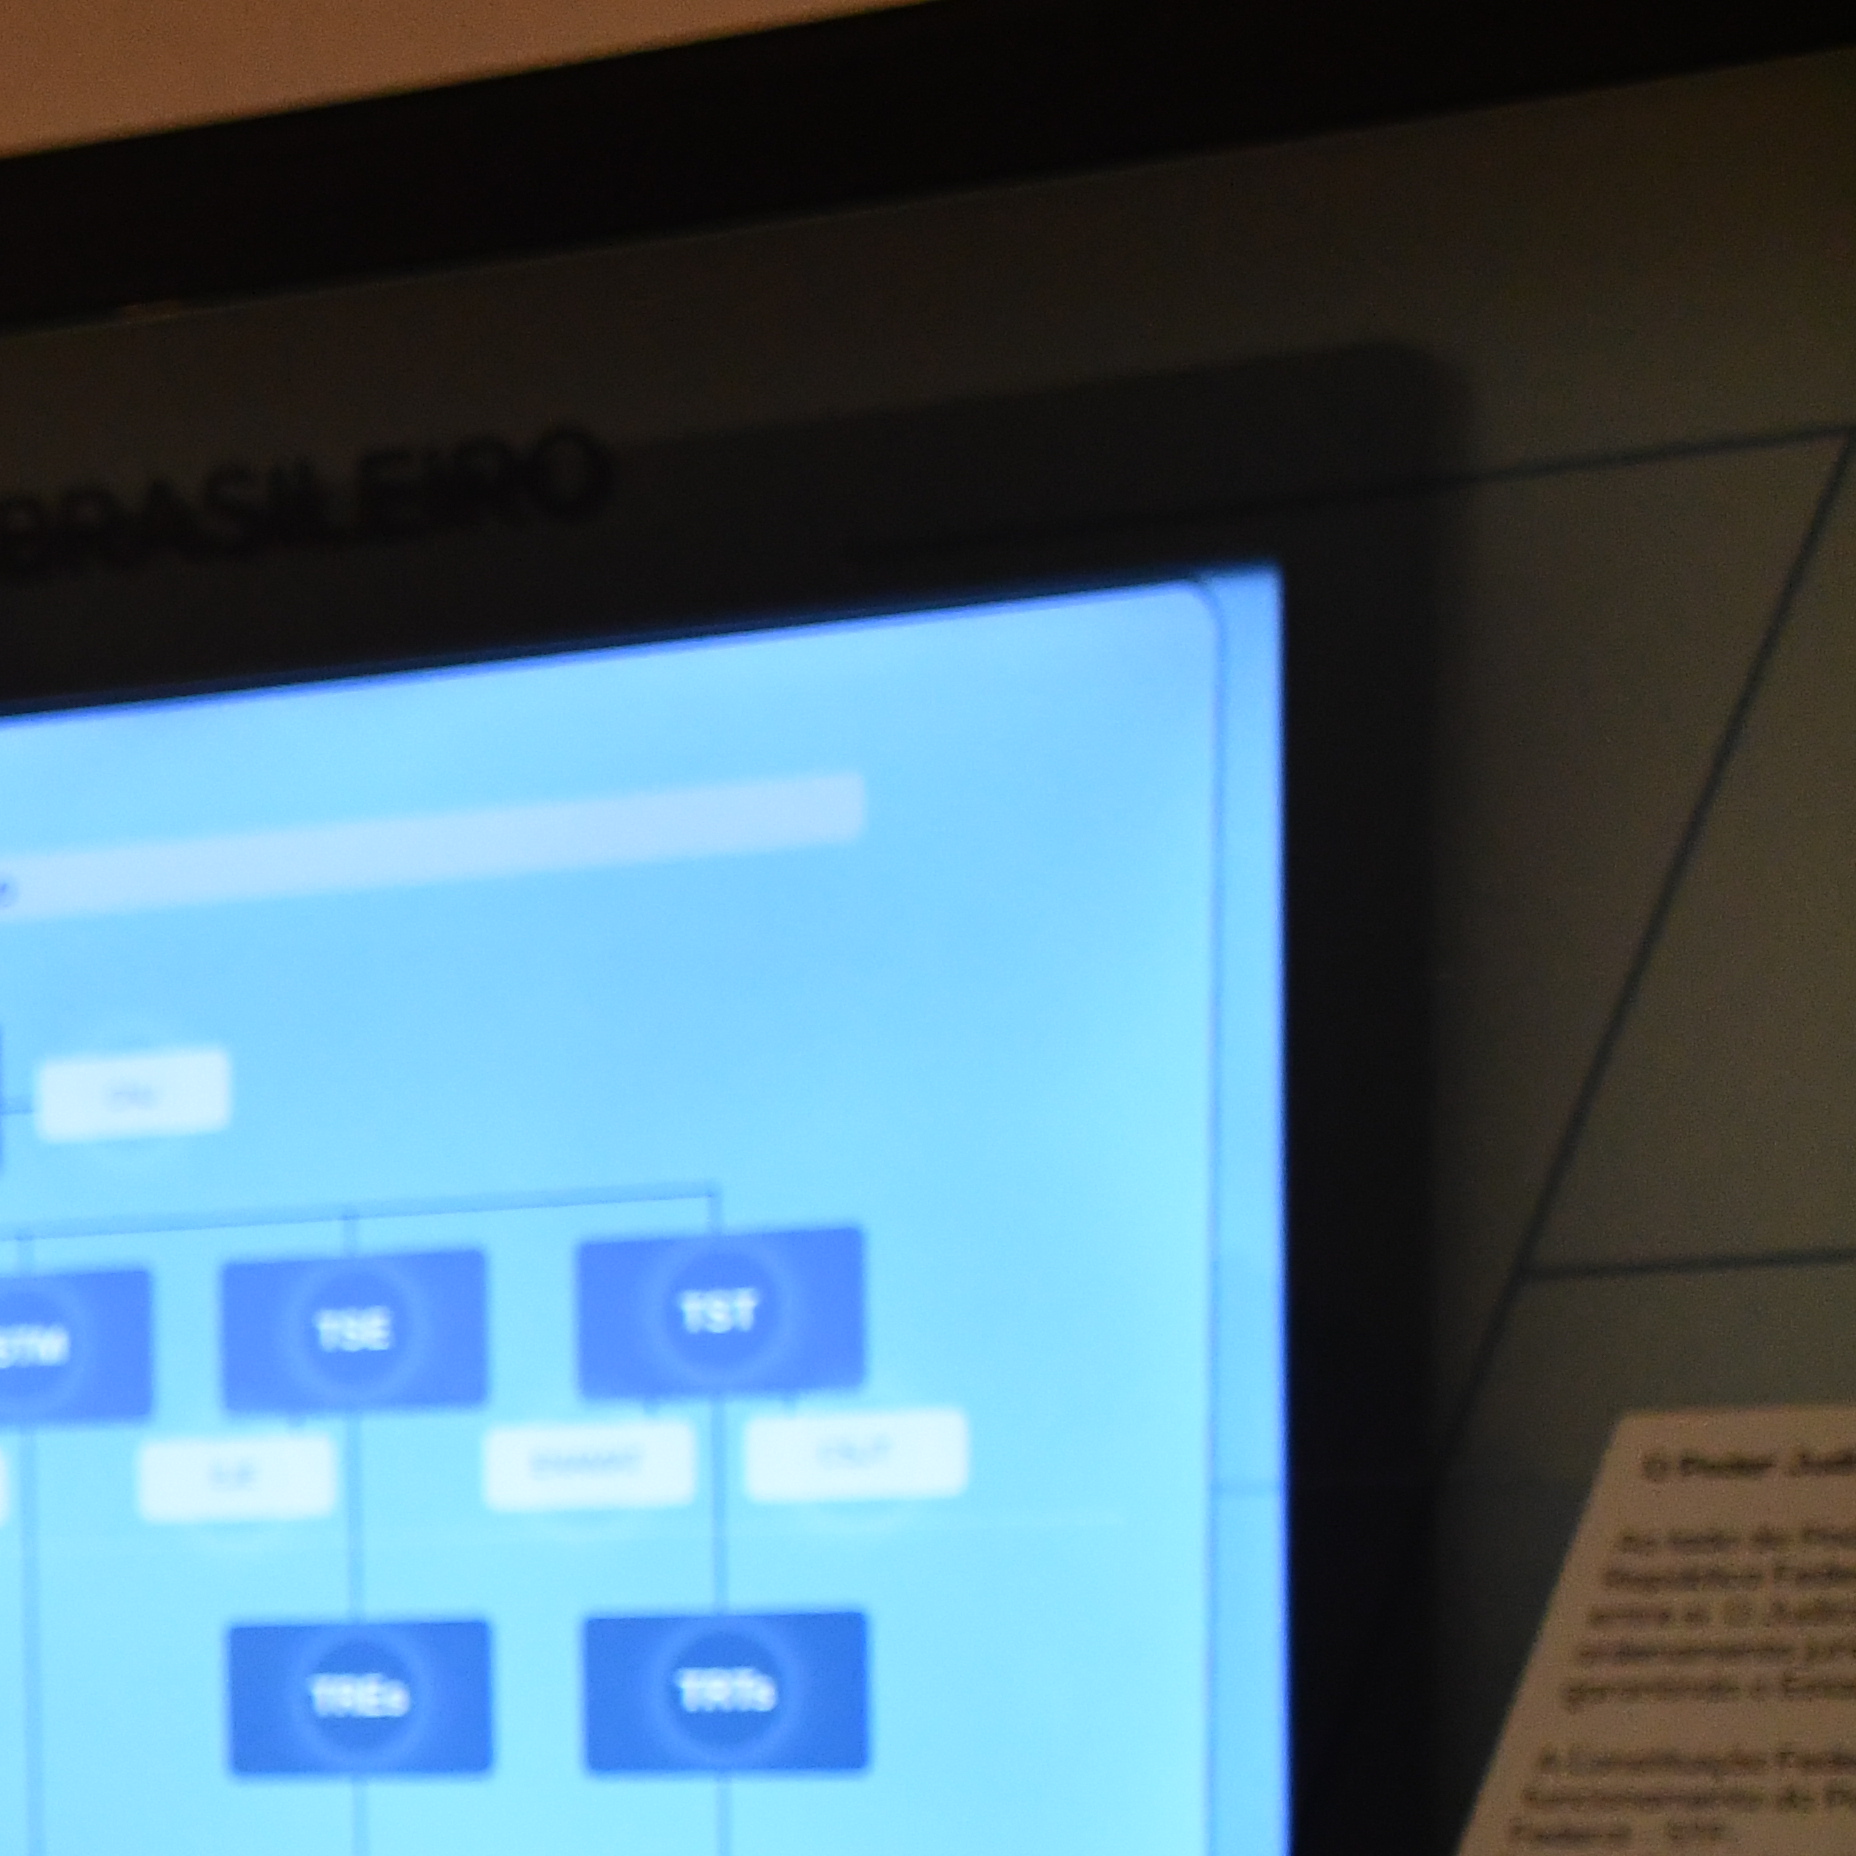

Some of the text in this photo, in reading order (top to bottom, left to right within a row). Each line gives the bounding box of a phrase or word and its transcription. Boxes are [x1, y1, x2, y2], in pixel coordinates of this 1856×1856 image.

[316, 1309, 391, 1354] TSE
[679, 1290, 757, 1334] TST
[308, 1676, 409, 1719] TREs
[676, 1670, 777, 1714] TRTs
